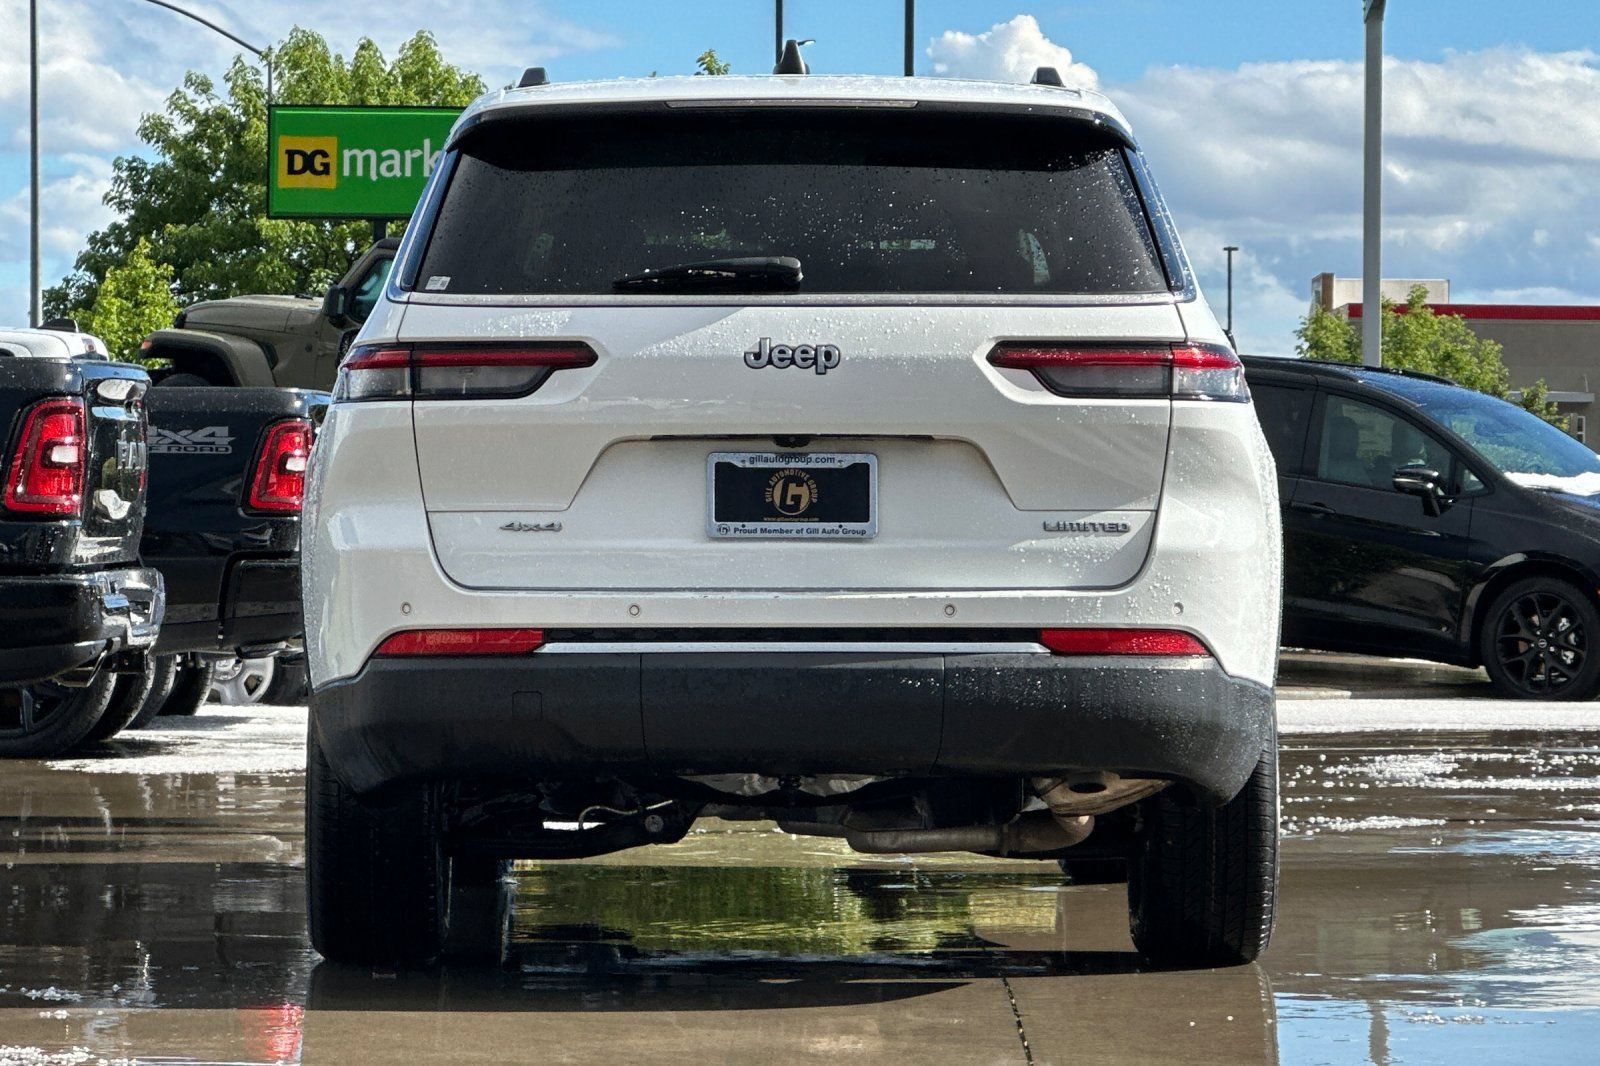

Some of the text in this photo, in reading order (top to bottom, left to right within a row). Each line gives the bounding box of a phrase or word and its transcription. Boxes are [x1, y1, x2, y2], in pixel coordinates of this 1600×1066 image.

[285, 149, 331, 176] DG
[743, 337, 841, 375] Jeep
[749, 454, 836, 465] gillautogroup.com
[733, 527, 867, 536] Proud Member of Gill Auto Group
[1043, 521, 1131, 533] LIMITED
